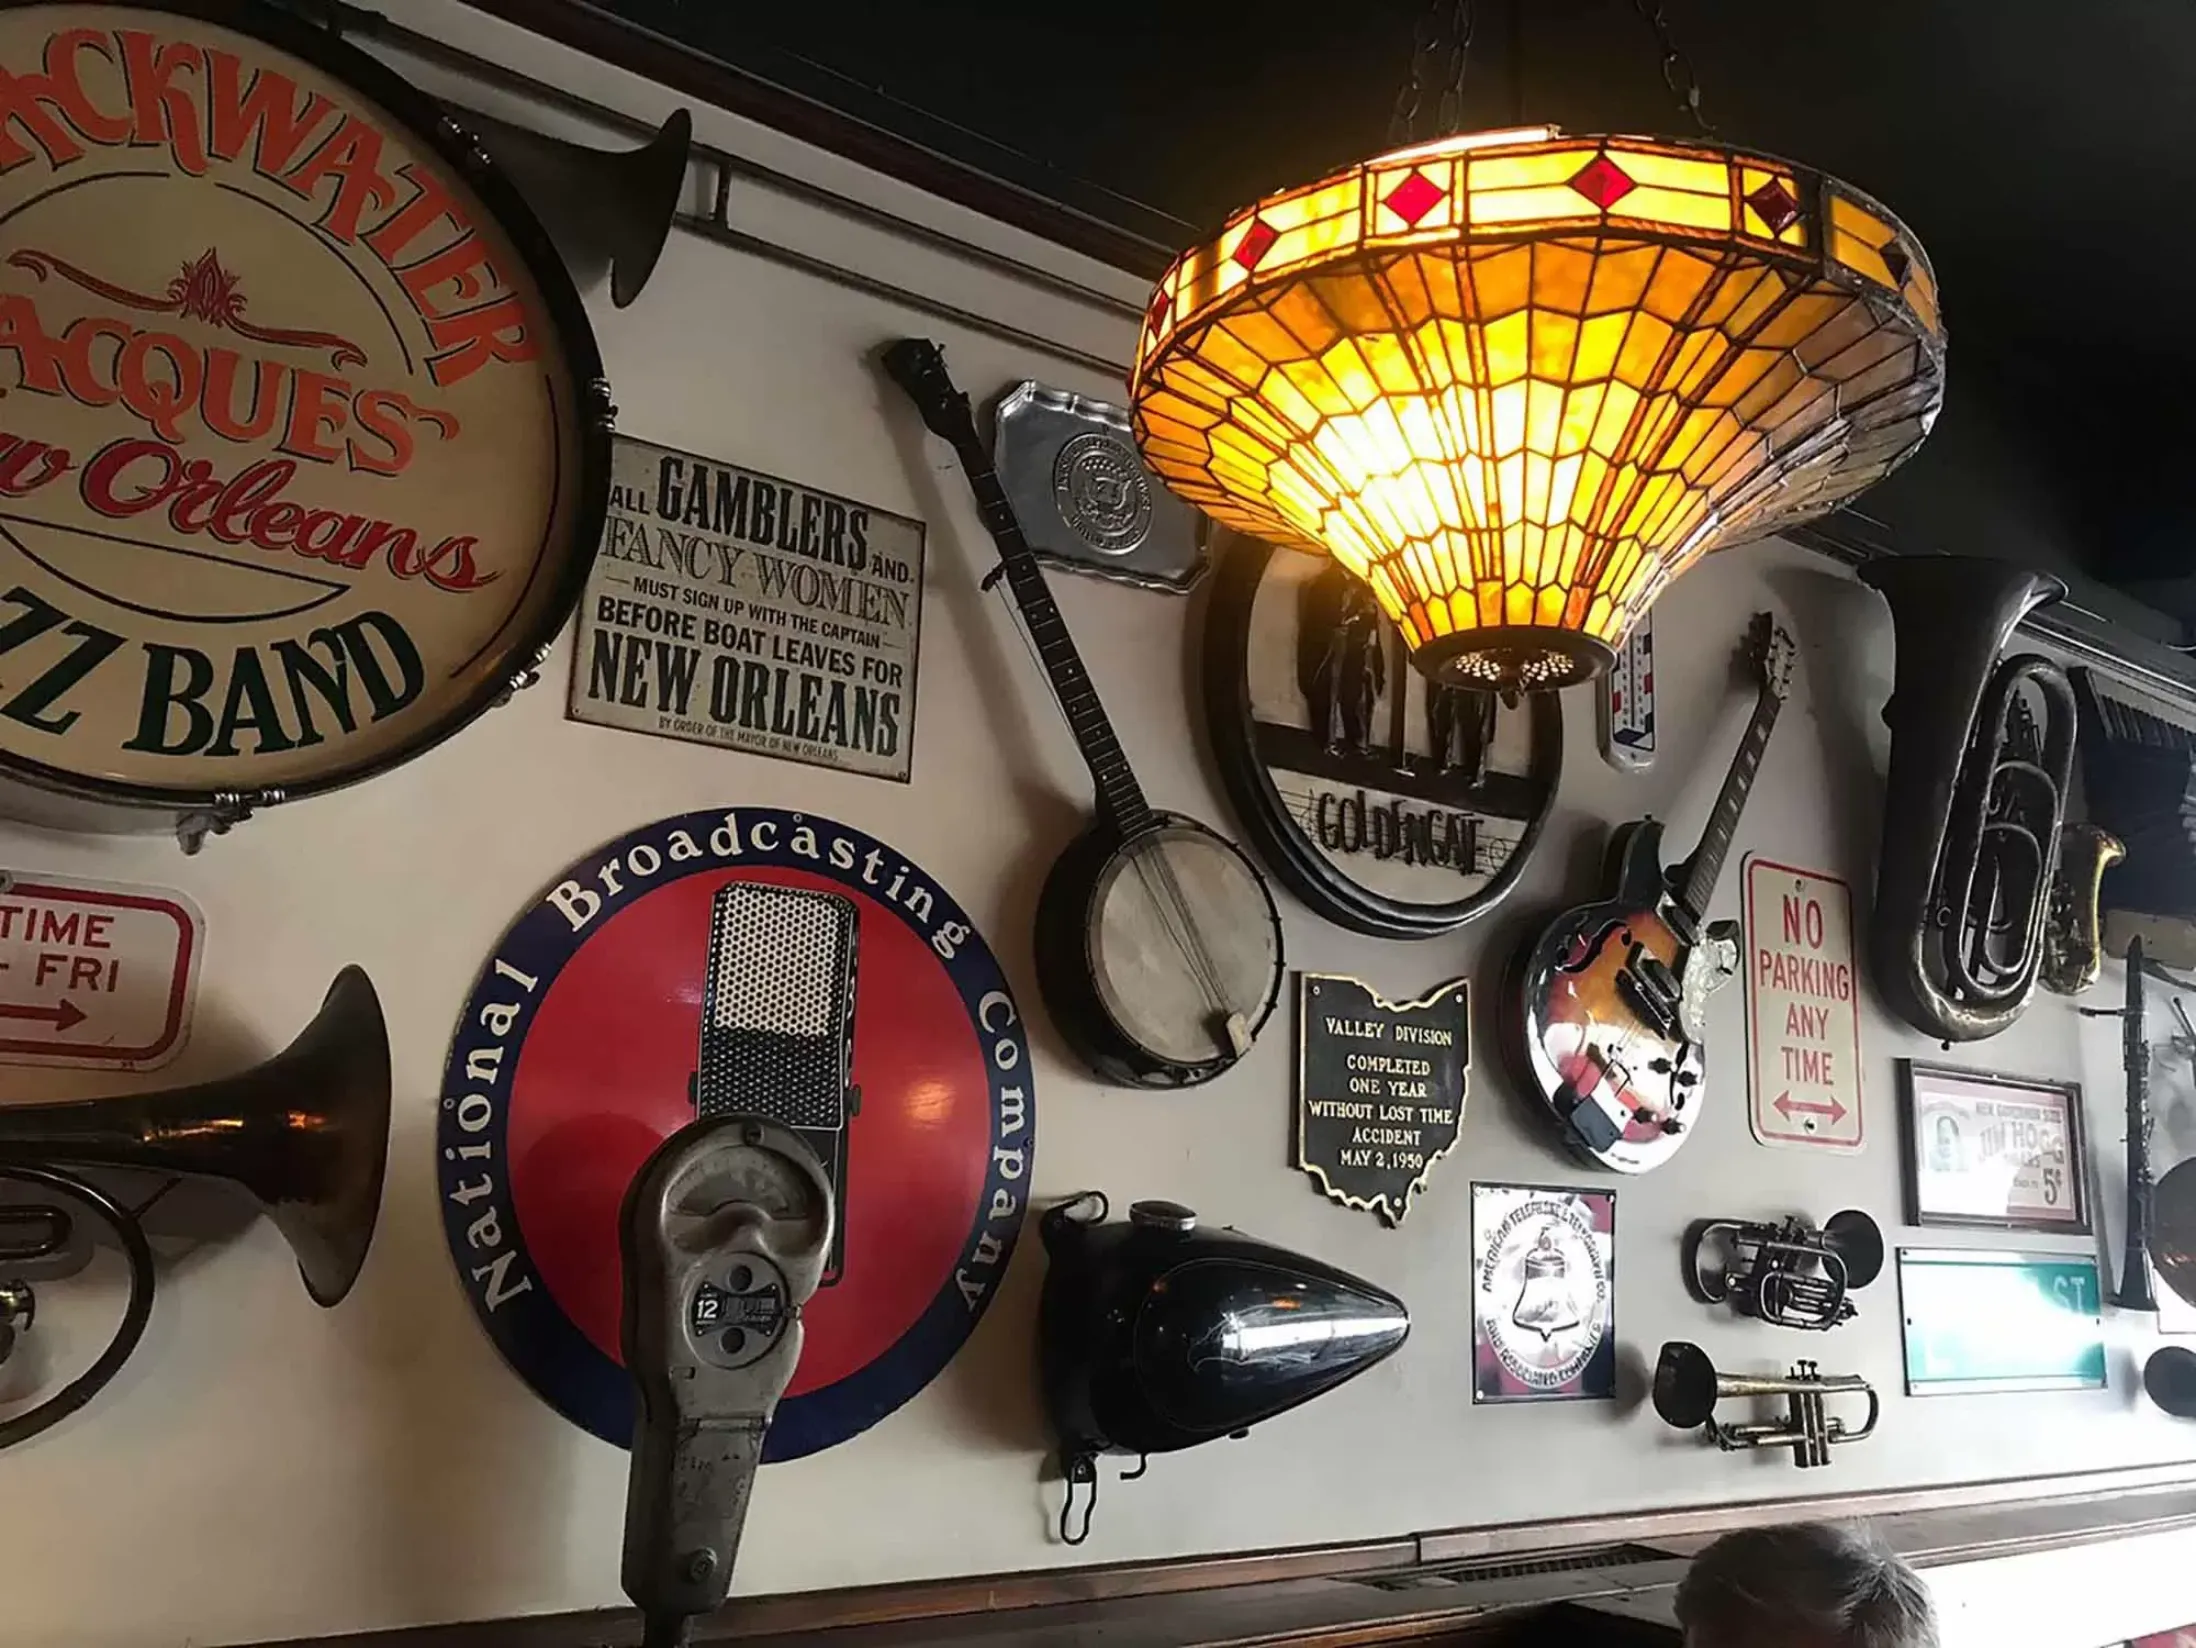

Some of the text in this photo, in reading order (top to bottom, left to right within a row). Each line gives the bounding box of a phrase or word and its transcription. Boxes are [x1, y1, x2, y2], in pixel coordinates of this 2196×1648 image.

[80, 437, 507, 593] Orleans
[610, 456, 909, 583] ALL GAMBLERS AND
[599, 515, 910, 629] FANCY WOMEN
[634, 576, 881, 649] MUST SIGN UP WITH THE CAPTAIN
[598, 595, 903, 689] BEFORE BOAT LEAVES FOR
[121, 610, 425, 757] BAND
[588, 629, 901, 757] NEW ORLEANS
[0, 905, 115, 949] TIME
[1783, 894, 1823, 949] NO
[35, 953, 119, 993] FRI
[1759, 949, 1850, 1001] PARKING
[1326, 1017, 1452, 1046] VALLEY DIVISION
[1785, 1002, 1829, 1040] ANY
[446, 813, 1026, 1313] National Broadcasting Company
[1347, 1054, 1431, 1076] COMPLETED
[1781, 1046, 1834, 1085] TIME
[1349, 1078, 1427, 1098] ONE YEAR
[1308, 1100, 1453, 1124] WITHOUT LOST TIME
[1340, 1150, 1371, 1167] MAY
[1353, 1128, 1422, 1147] ACCIDENT
[697, 1299, 718, 1319] 12
